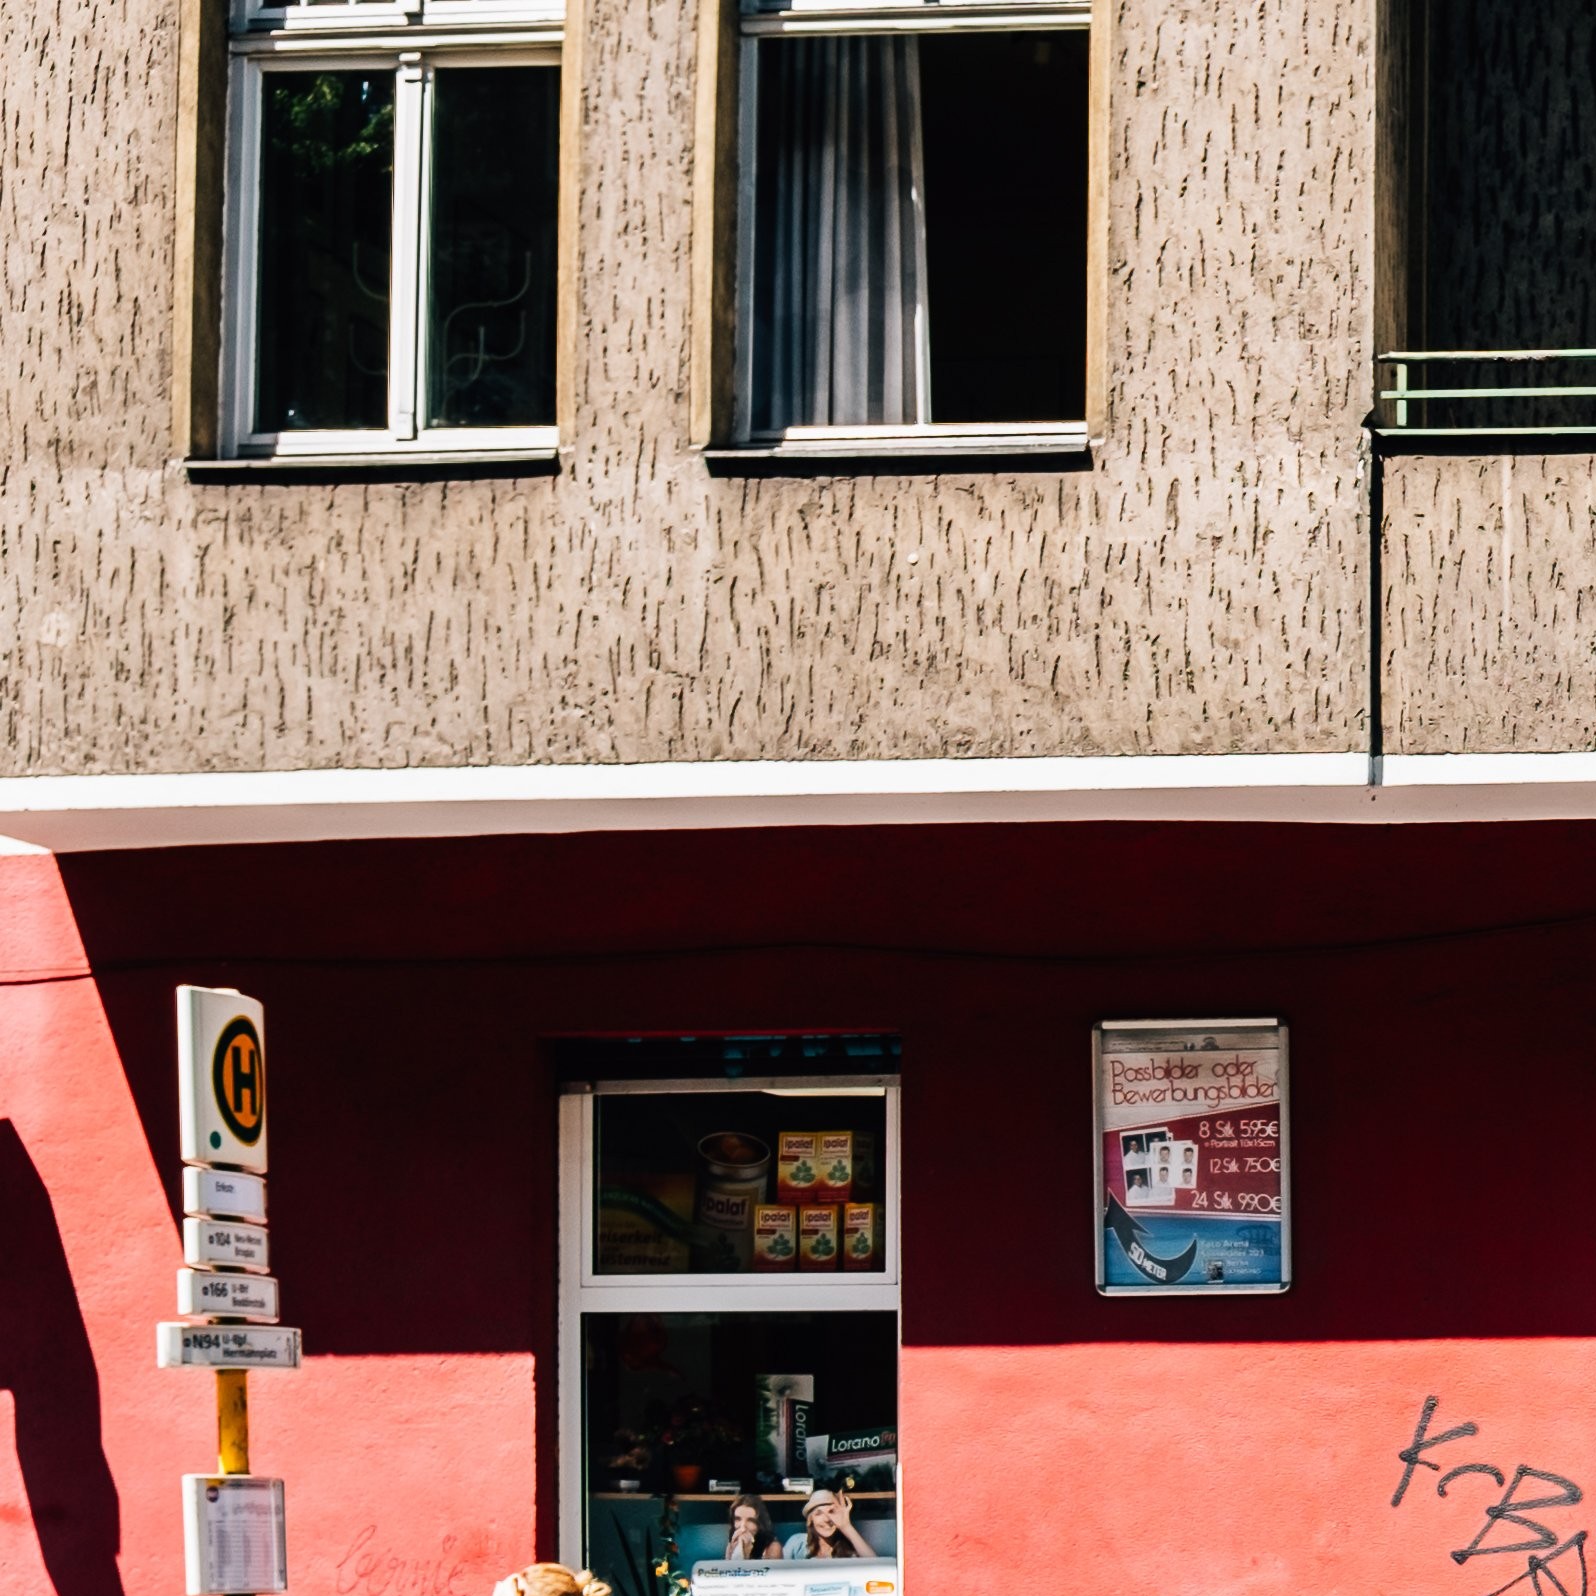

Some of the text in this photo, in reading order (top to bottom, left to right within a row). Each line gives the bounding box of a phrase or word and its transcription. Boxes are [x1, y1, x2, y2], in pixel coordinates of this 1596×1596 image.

[1110, 1054, 1258, 1084] Passbilder oder
[232, 1045, 257, 1116] H
[1111, 1077, 1279, 1108] Bewerbungsbilder
[1199, 1121, 1210, 1138] 8
[1209, 1158, 1222, 1173] 12
[1191, 1191, 1208, 1208] 24
[210, 1282, 228, 1297] 166
[193, 1334, 221, 1349] N94
